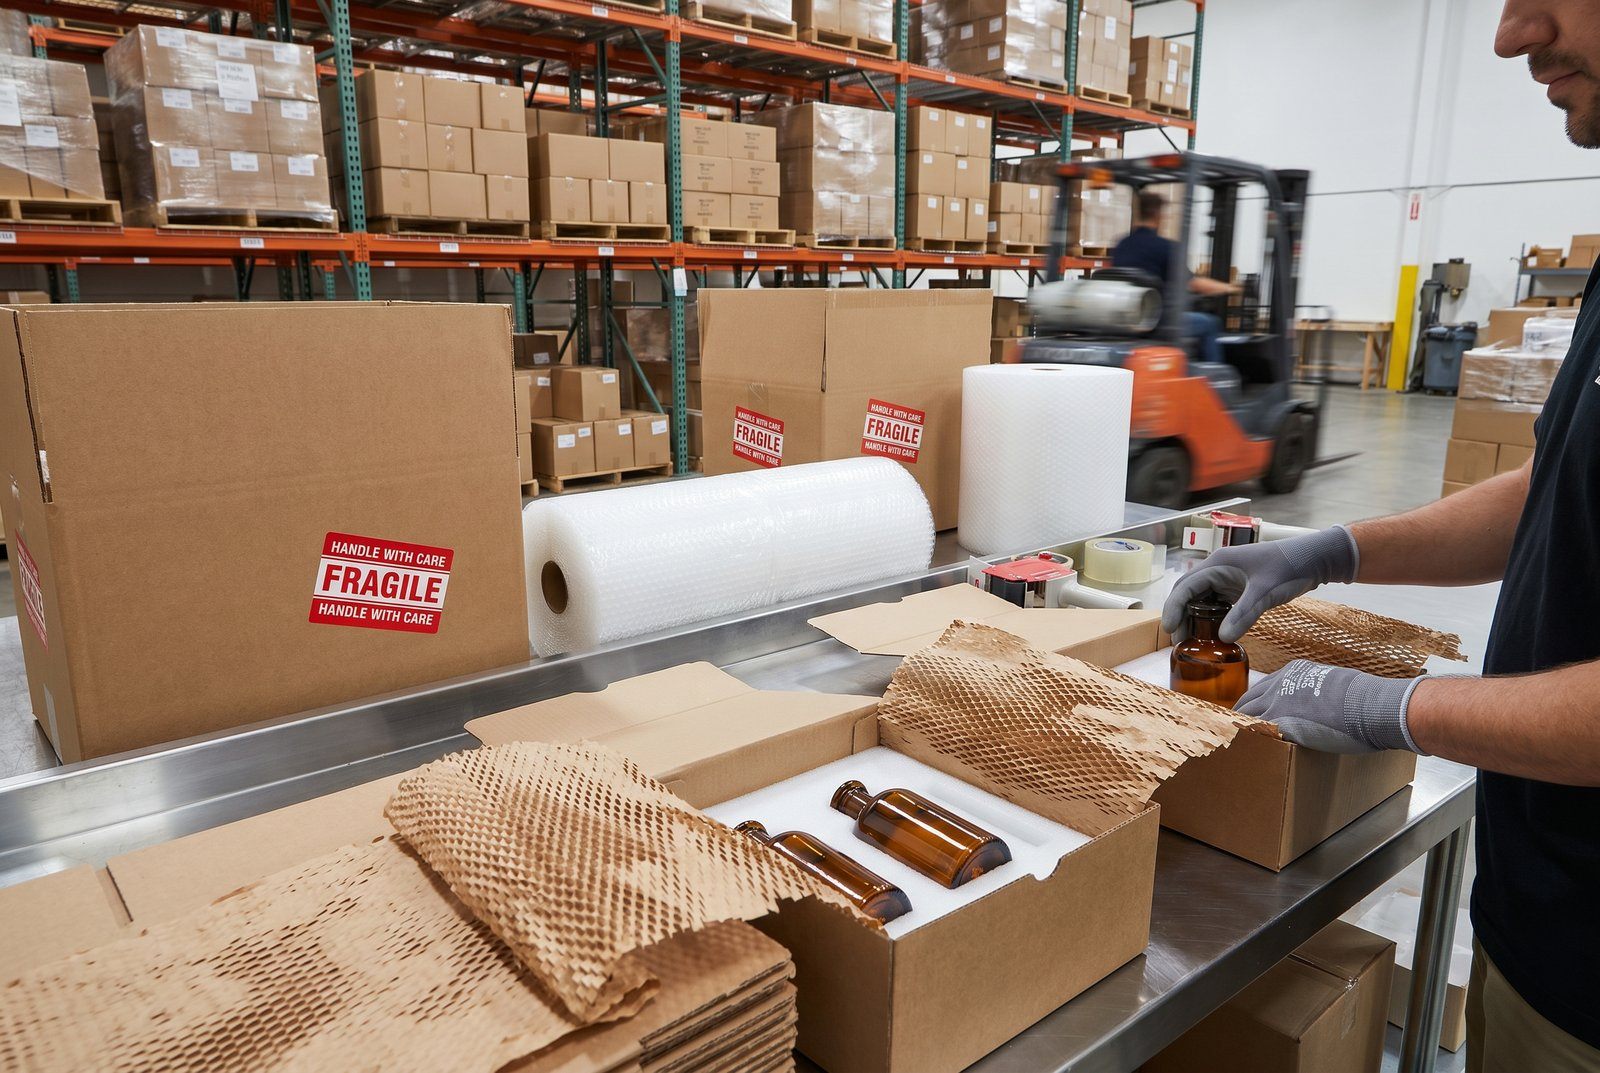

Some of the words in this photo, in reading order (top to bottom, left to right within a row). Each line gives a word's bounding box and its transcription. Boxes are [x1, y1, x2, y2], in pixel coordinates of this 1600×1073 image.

[768, 422, 781, 431] CARE
[894, 409, 907, 419] WITH
[908, 412, 921, 422] CARE
[736, 424, 780, 453] FRAGILE
[867, 418, 919, 444] FRAGILE
[902, 449, 916, 458] CARE
[331, 541, 380, 558] HANDLE
[384, 549, 414, 563] WITH
[416, 554, 446, 567] CARE
[322, 564, 442, 603] FRAGILE
[319, 603, 367, 619] HANDLE
[371, 608, 400, 622] WITH
[404, 612, 433, 626] CARE
